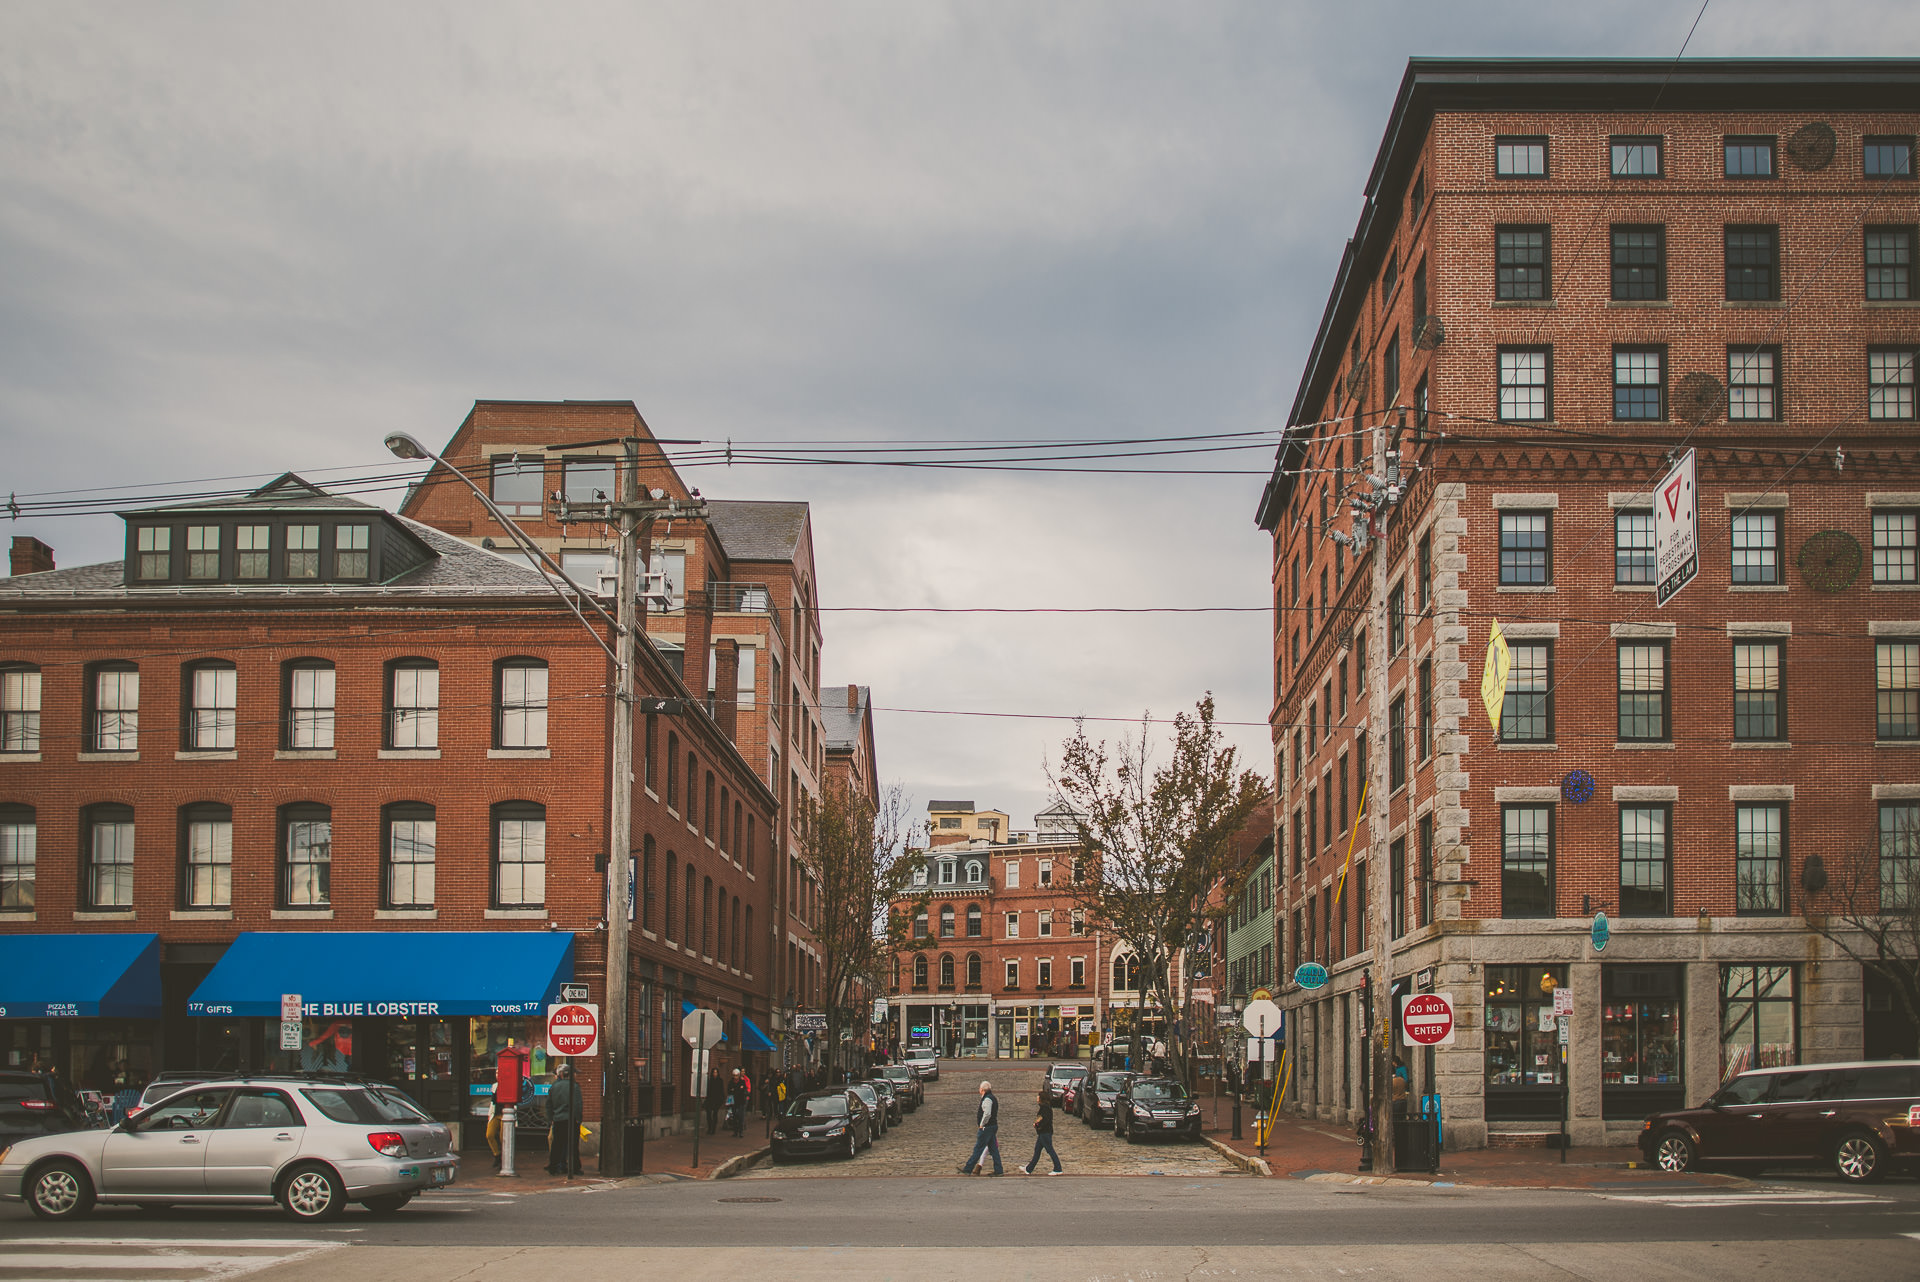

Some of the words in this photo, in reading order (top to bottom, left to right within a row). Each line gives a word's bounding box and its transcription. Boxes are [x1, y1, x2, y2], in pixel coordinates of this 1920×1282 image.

[1670, 529, 1680, 545] FOR
[1659, 531, 1692, 565] PEDESTRIANS
[1659, 569, 1664, 578] IN
[1664, 542, 1694, 576] CROSSWALK
[1660, 583, 1670, 599] IT'S
[1671, 571, 1681, 587] THE
[1681, 559, 1694, 580] LAW
[1298, 967, 1325, 976] CARD
[1295, 976, 1329, 984] WORKS
[569, 989, 577, 998] ONE
[577, 989, 586, 998] WAY
[189, 1003, 204, 1011] 177
[206, 1005, 233, 1014] GIFTS
[323, 1003, 363, 1016] BLUE
[367, 1003, 439, 1015] LOBSTER
[490, 1004, 521, 1013] TOURS
[523, 1002, 539, 1010] 177
[1410, 1005, 1422, 1013] DO
[1426, 1003, 1445, 1012] NOT
[556, 1015, 568, 1023] DO
[572, 1015, 590, 1023] NOT
[1414, 1025, 1443, 1035] ENTER
[559, 1037, 587, 1045] ENTER
